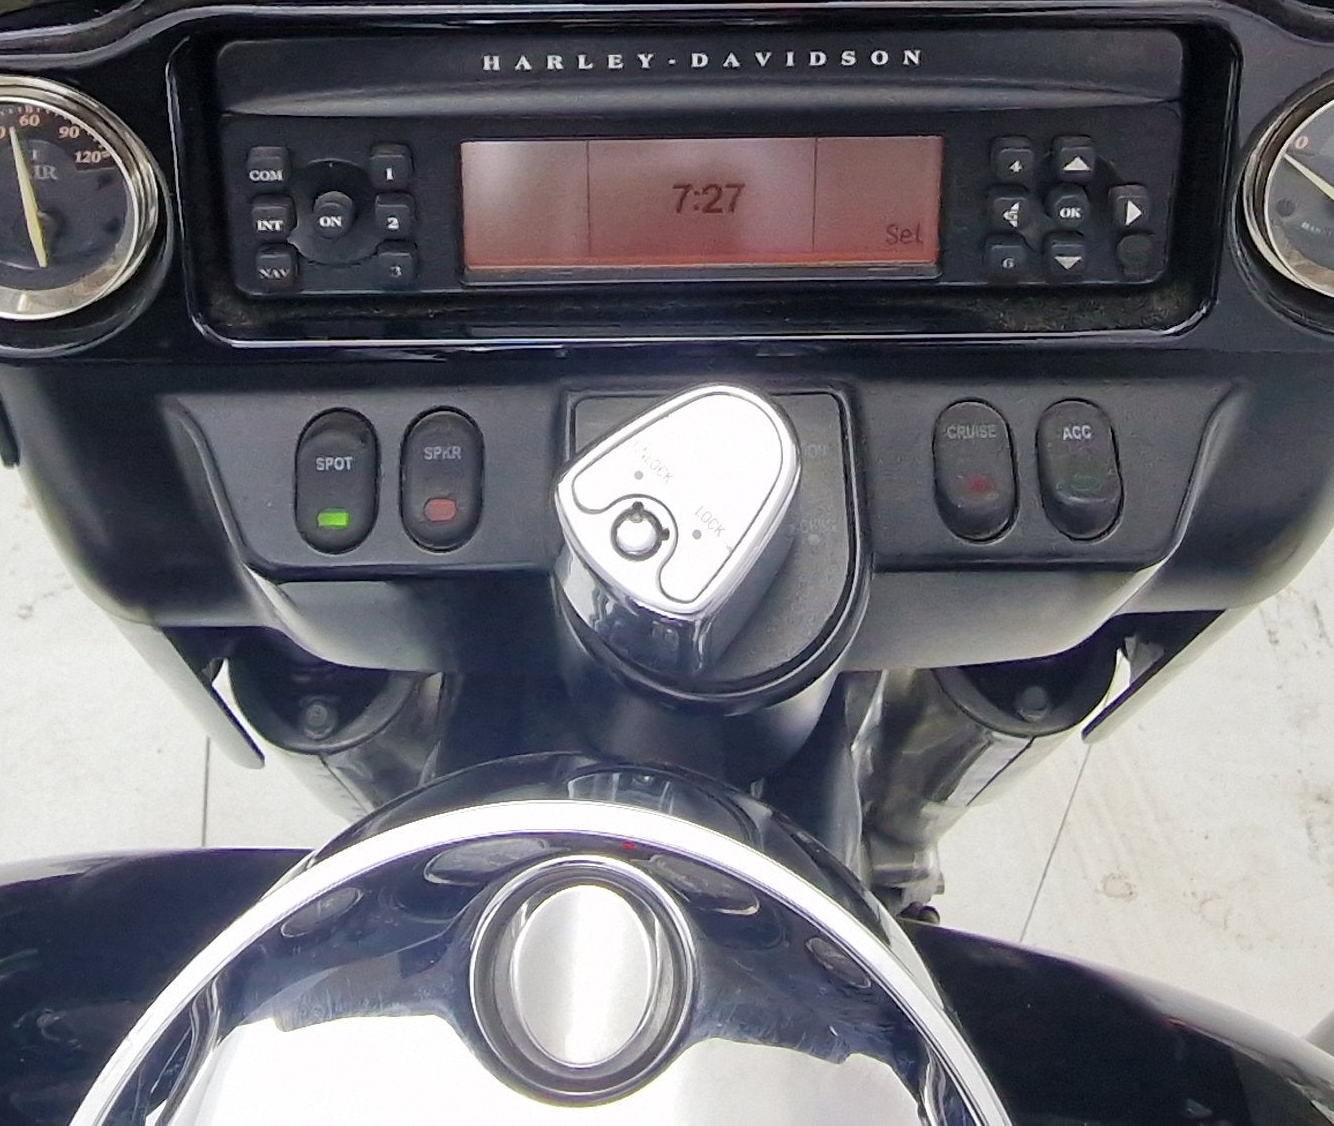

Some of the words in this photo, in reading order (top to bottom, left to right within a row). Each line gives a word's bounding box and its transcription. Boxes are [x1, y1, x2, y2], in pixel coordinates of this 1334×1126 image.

[482, 48, 923, 72] HARLEY-DAVIDSON
[18, 114, 41, 127] 60
[58, 126, 81, 140] 90
[1294, 136, 1309, 150] 0
[75, 150, 103, 164] 120
[1008, 160, 1023, 173] 4
[248, 170, 284, 182] COM
[386, 168, 394, 180] 1
[672, 183, 746, 214] 7:27
[1059, 207, 1082, 218] OK
[257, 219, 283, 231] INT
[319, 215, 342, 227] ON
[386, 216, 399, 229] 2
[885, 222, 924, 245] Sel
[1002, 257, 1014, 269] 6
[258, 267, 291, 279] NAV
[390, 266, 402, 278] 3
[945, 424, 997, 440] CRUISE
[1062, 424, 1093, 440] ACC
[422, 445, 462, 461] SPKR
[316, 456, 353, 471] SPOT
[693, 505, 726, 538] LOCK
